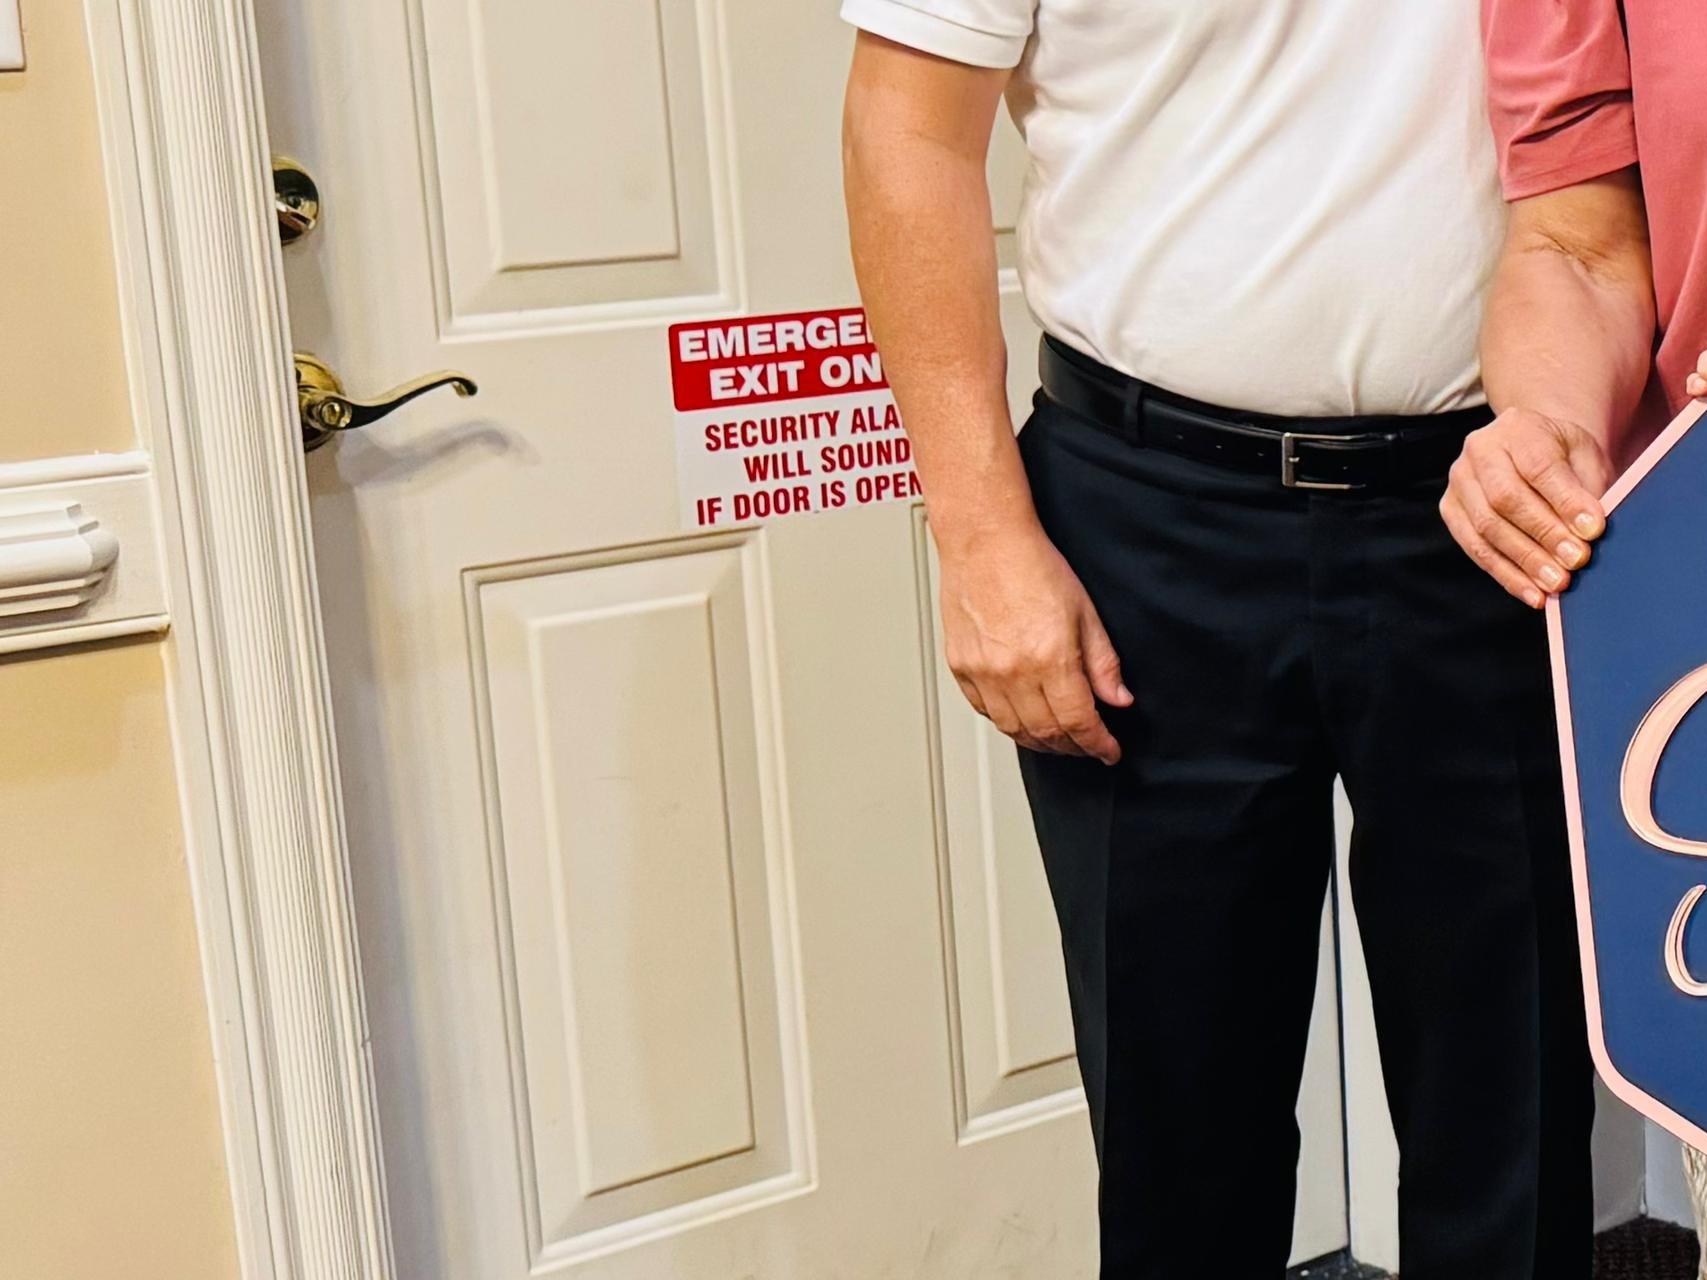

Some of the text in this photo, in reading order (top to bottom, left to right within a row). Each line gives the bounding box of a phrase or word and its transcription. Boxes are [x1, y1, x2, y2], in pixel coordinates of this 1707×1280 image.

[678, 313, 873, 362] EMERGE
[709, 352, 883, 401] EXIT ON
[704, 404, 901, 452] SECURITY ALA
[744, 437, 911, 483] WILL SOUND
[697, 471, 923, 525] IF DOOR IS OPEN
